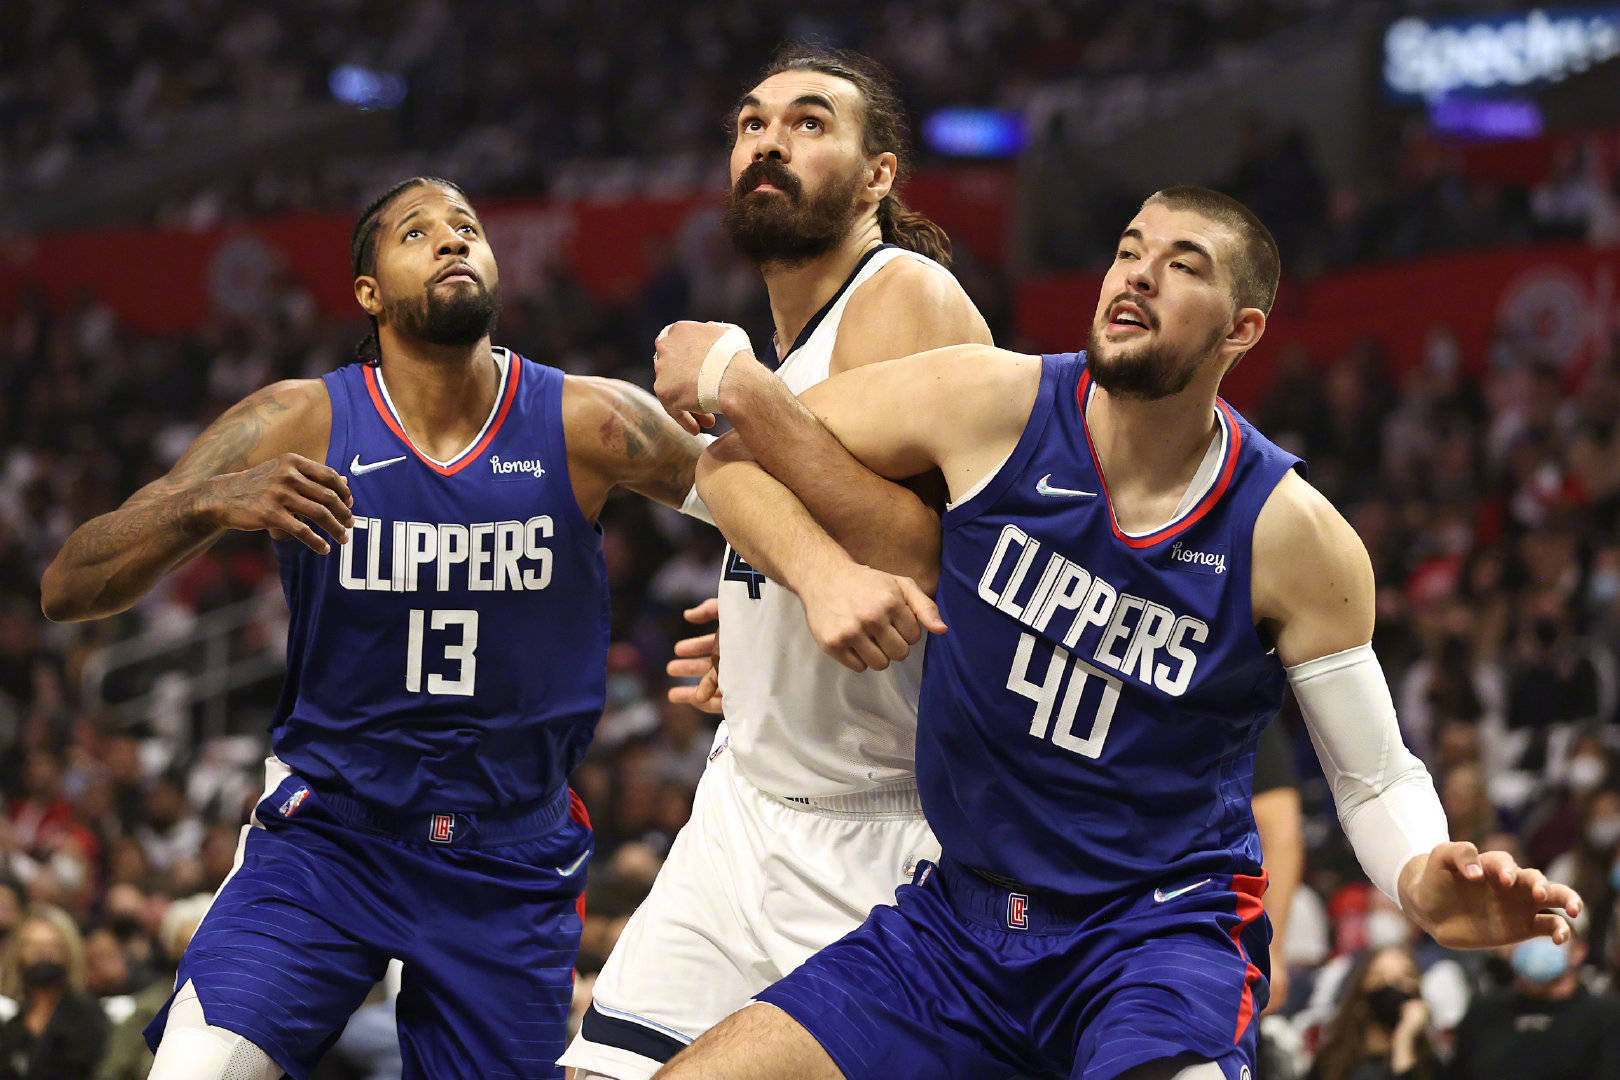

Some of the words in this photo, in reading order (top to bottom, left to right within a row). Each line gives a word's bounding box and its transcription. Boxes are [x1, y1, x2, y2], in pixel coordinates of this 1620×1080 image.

[490, 456, 545, 478] honey
[340, 514, 554, 592] CLIPPERS
[1171, 541, 1226, 574] honey
[977, 523, 1209, 697] CLIPPERS
[406, 609, 479, 696] 13
[1006, 632, 1123, 759] 40
